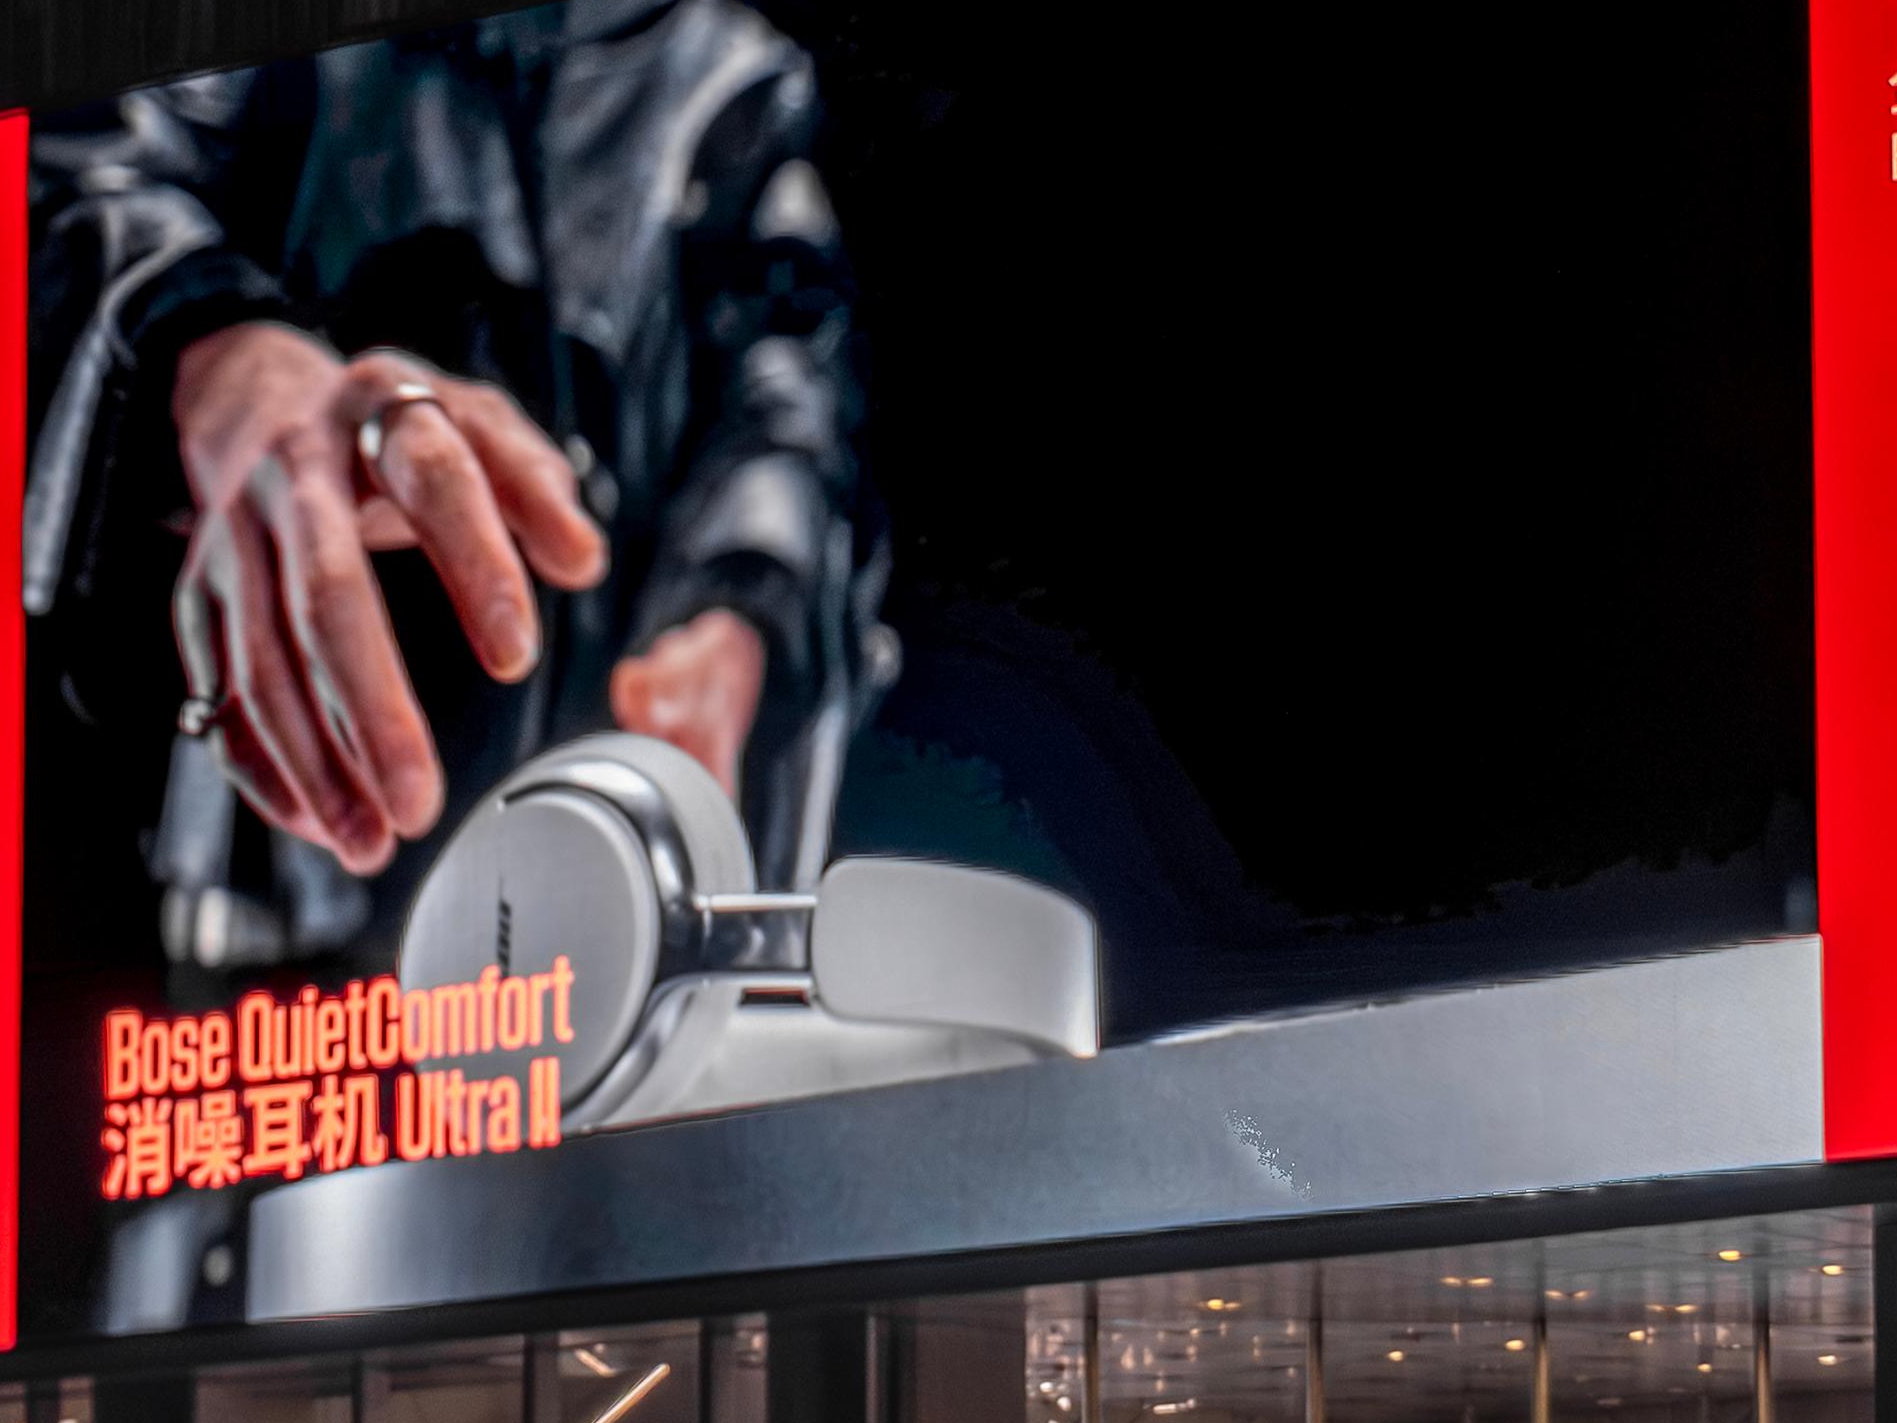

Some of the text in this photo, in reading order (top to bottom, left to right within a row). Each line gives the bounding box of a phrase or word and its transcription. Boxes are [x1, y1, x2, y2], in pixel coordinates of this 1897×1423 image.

[105, 955, 575, 1100] Bose QuietComfort
[102, 1073, 388, 1200] 消噪耳机
[396, 1068, 521, 1161] Ultra
